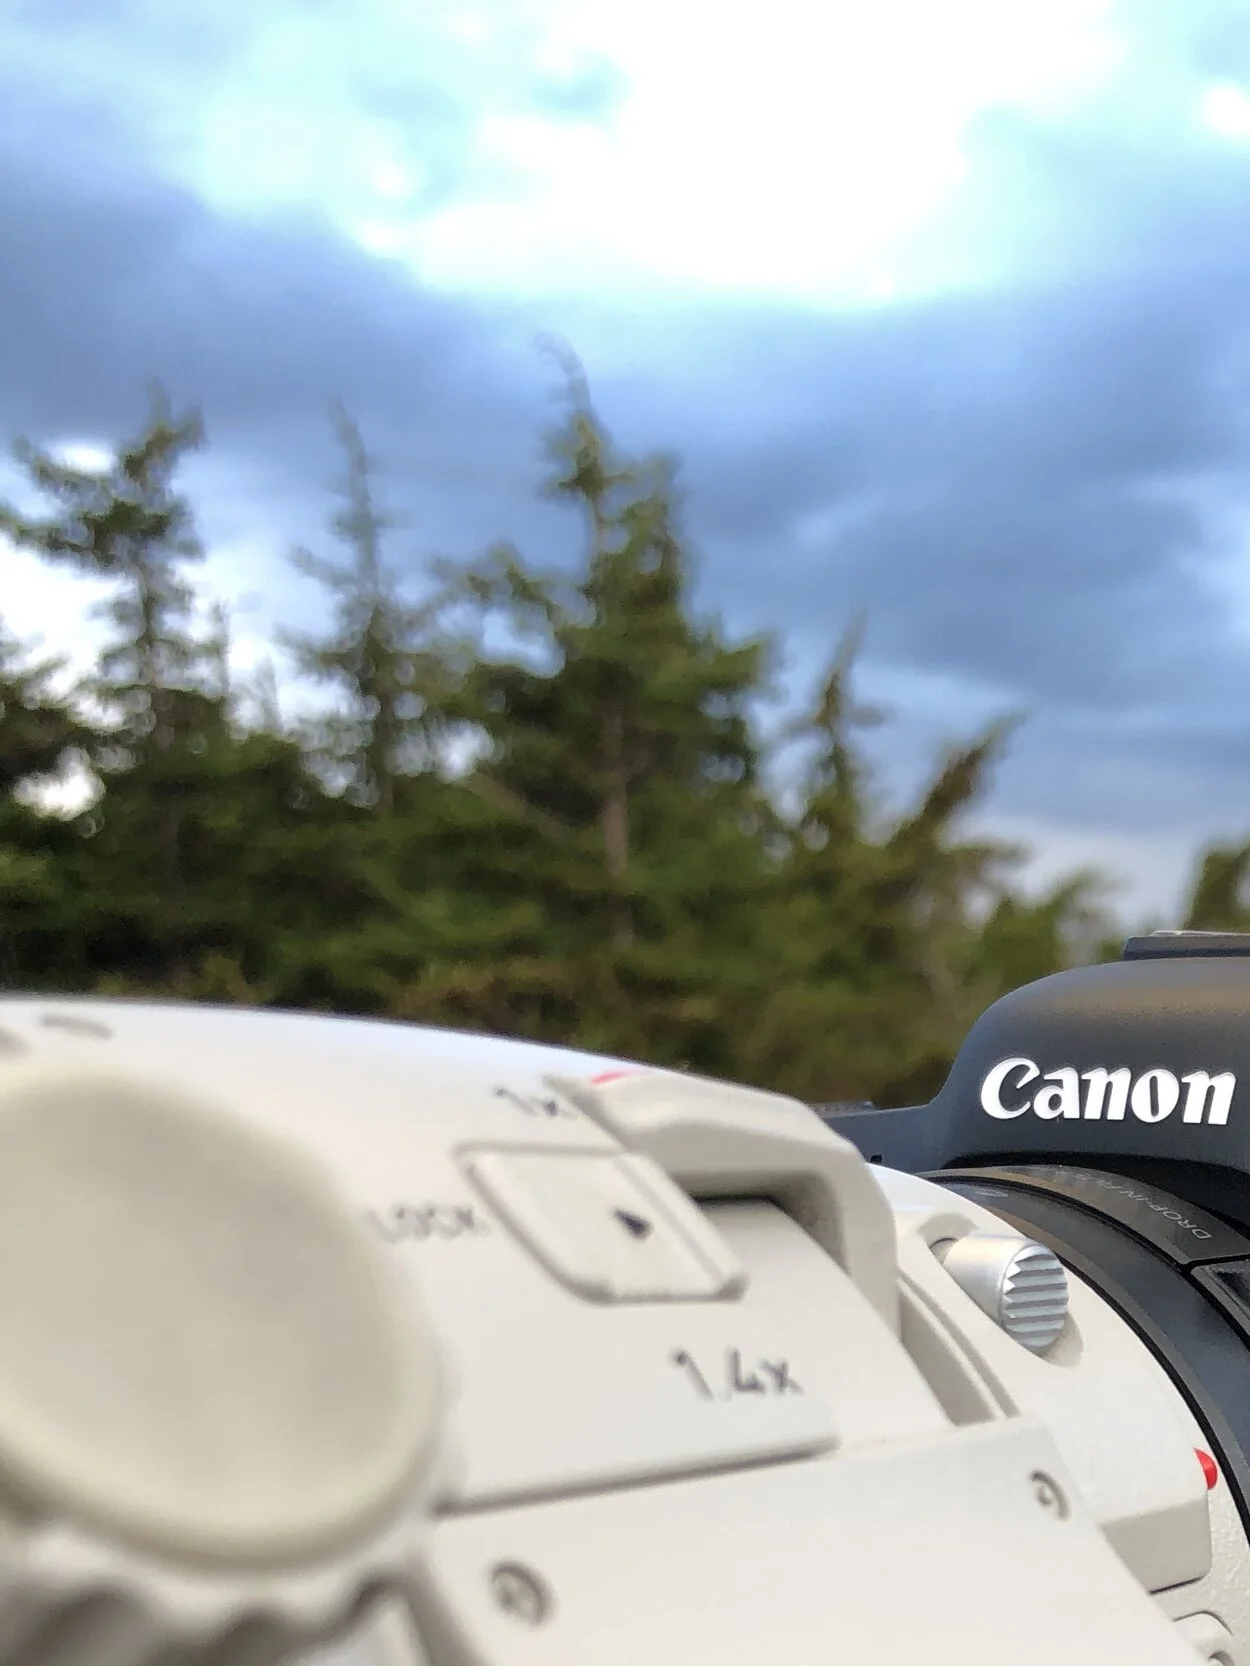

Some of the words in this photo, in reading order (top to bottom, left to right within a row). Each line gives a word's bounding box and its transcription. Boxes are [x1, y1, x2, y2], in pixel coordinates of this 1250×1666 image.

[980, 1057, 1236, 1125] Canon
[1119, 1189, 1213, 1240] DROP-IN
[669, 1346, 804, 1402] 1.4x
